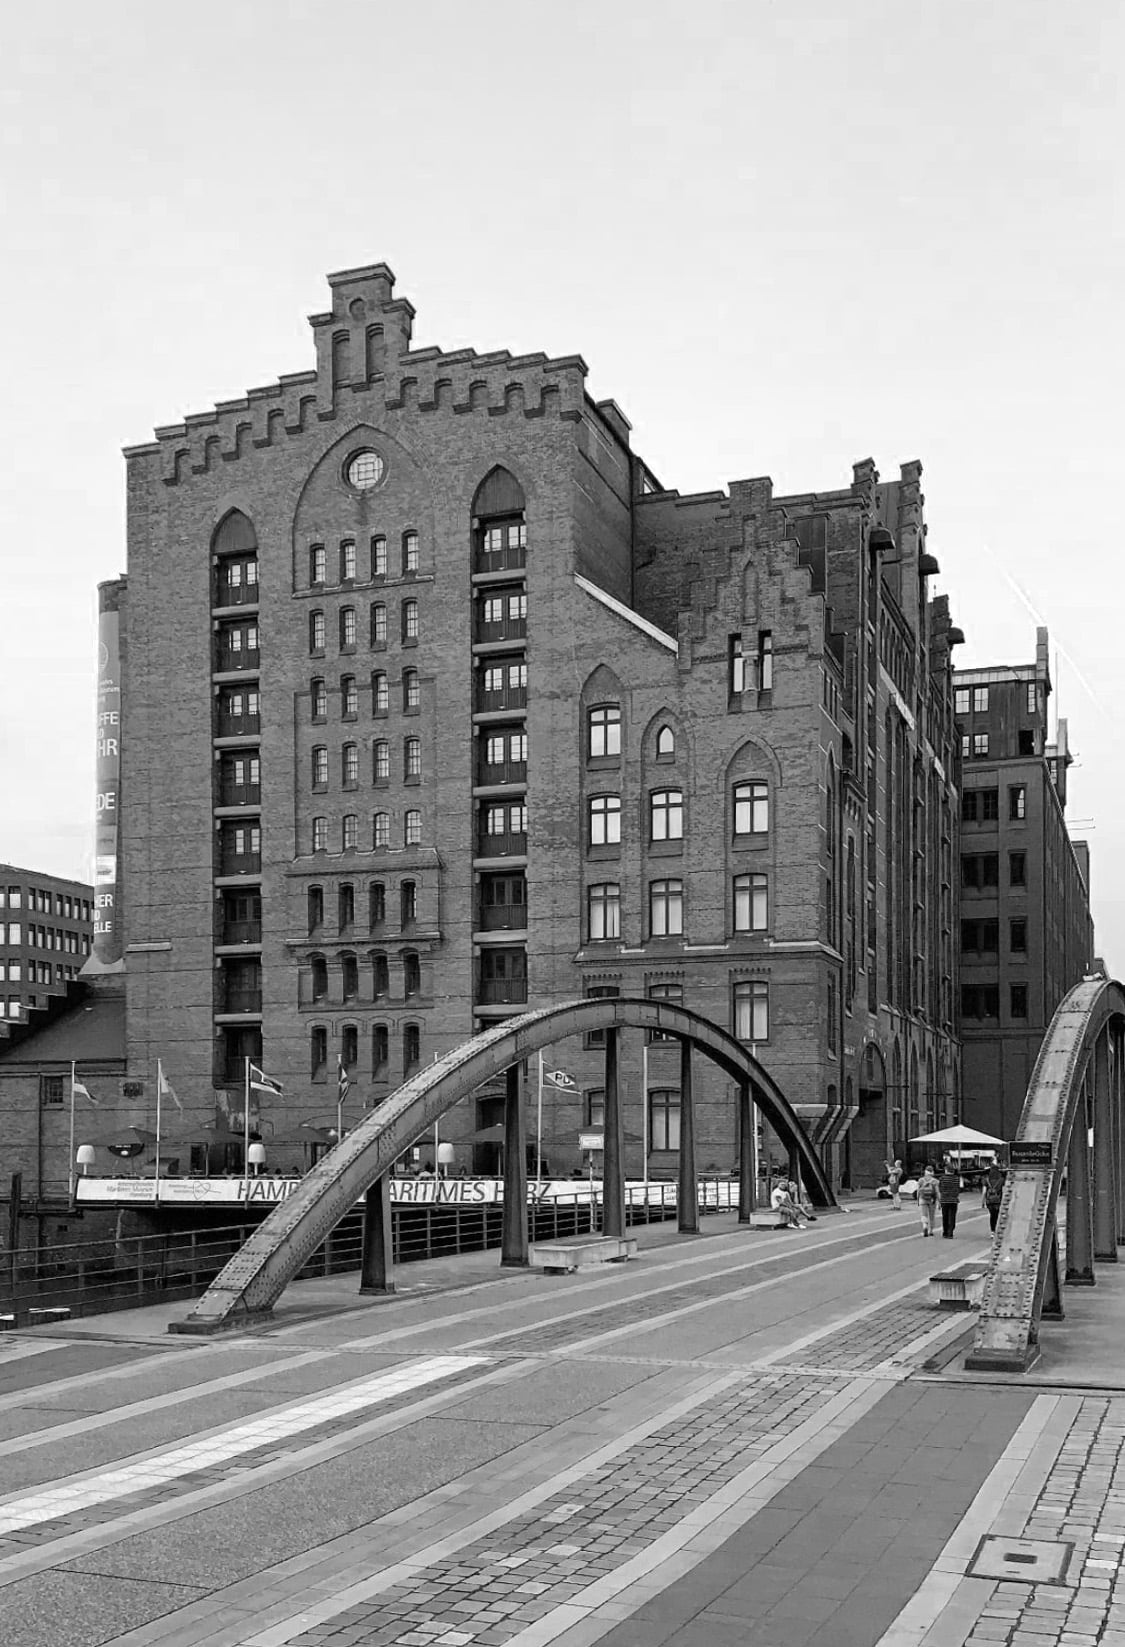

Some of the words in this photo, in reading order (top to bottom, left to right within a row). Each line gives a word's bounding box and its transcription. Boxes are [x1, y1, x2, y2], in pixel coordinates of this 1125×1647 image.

[99, 711, 119, 726] FFE
[97, 738, 118, 757] HR
[96, 792, 116, 811] DE
[389, 1181, 486, 1202] ARITIMES
[494, 1182, 552, 1202] HRZ
